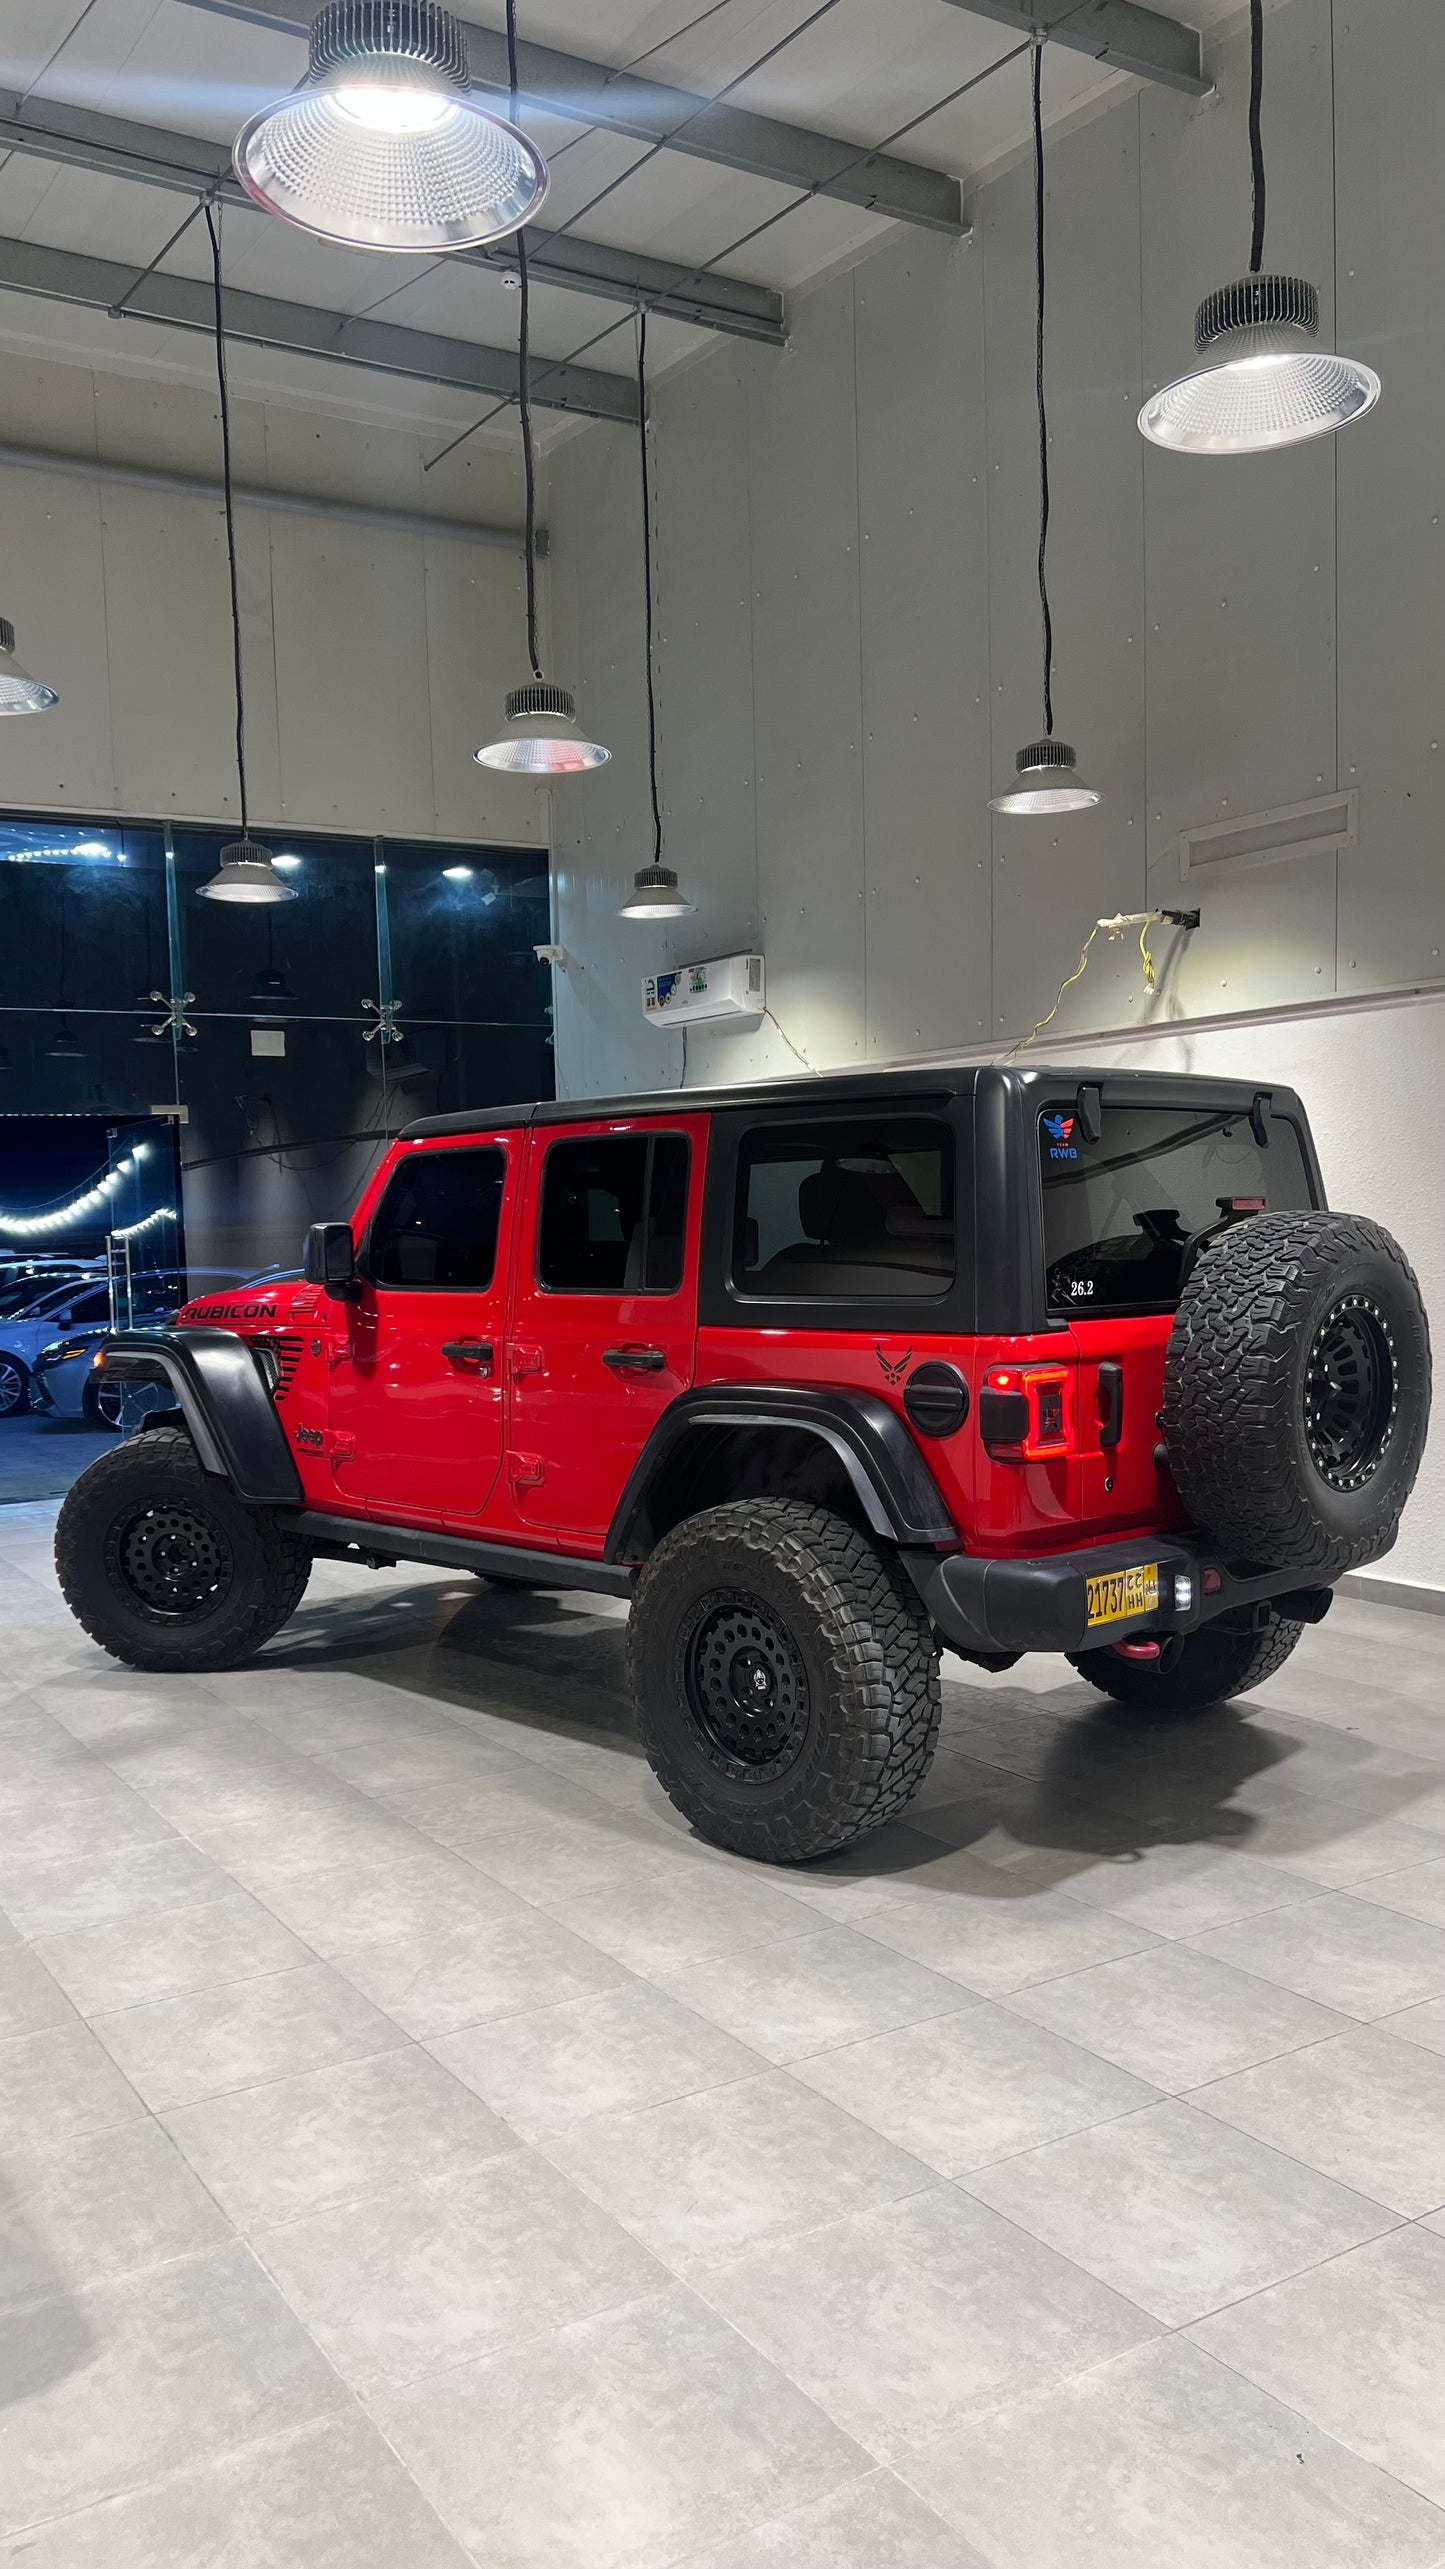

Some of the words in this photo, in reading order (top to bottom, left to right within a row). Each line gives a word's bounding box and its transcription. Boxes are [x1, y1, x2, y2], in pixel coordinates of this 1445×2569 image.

[1050, 1147, 1078, 1159] RWB
[1070, 1280, 1094, 1297] 26.2
[183, 1304, 278, 1320] RUBICON
[295, 1423, 323, 1447] Jeep
[1087, 1577, 1124, 1619] 21737
